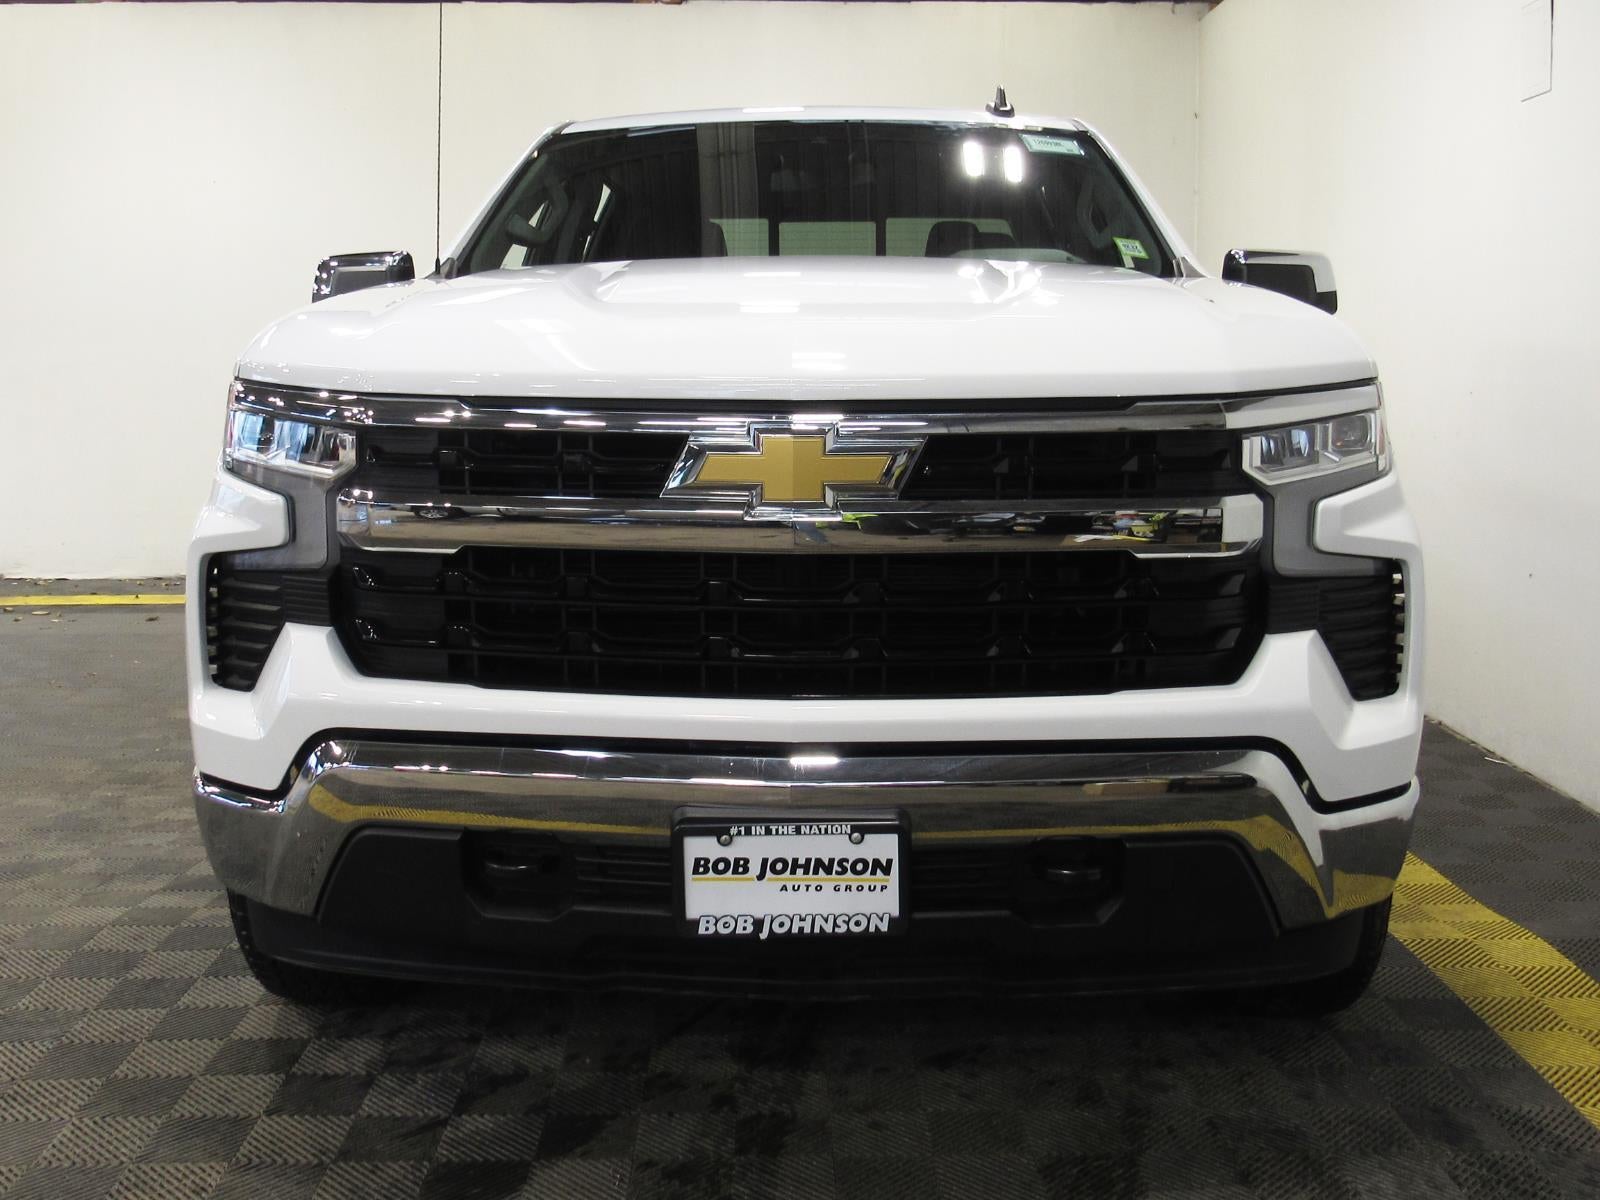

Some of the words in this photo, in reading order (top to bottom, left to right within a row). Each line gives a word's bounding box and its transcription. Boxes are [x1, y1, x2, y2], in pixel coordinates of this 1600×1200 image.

[730, 826, 745, 835] #1
[752, 826, 765, 835] IN
[770, 825, 796, 834] THE
[801, 824, 852, 834] NATION
[692, 857, 750, 875] BOB
[756, 857, 893, 881] JOHNSON
[780, 884, 823, 892] AUTO
[834, 884, 888, 892] GROUP
[698, 914, 754, 935] BOB
[759, 913, 890, 940] JOHNSON
